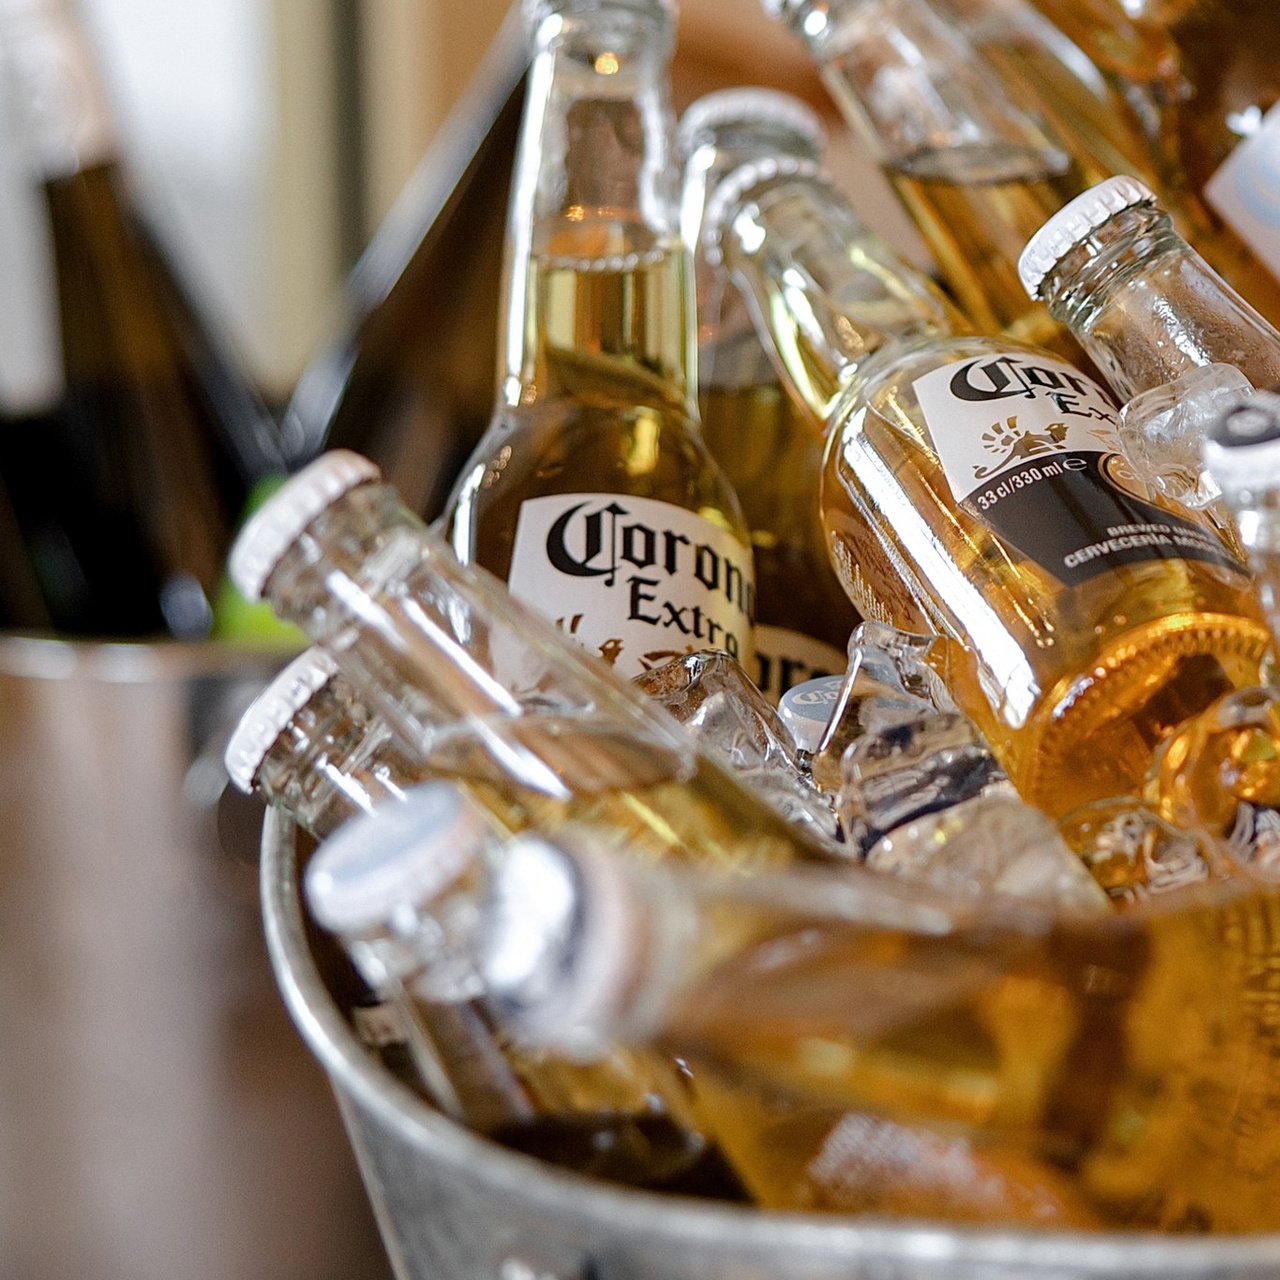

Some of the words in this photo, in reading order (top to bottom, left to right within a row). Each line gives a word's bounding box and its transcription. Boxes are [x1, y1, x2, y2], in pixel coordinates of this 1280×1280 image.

[949, 356, 1116, 411] Cor
[1106, 523, 1172, 538] BREWED
[626, 575, 740, 660] Extra
